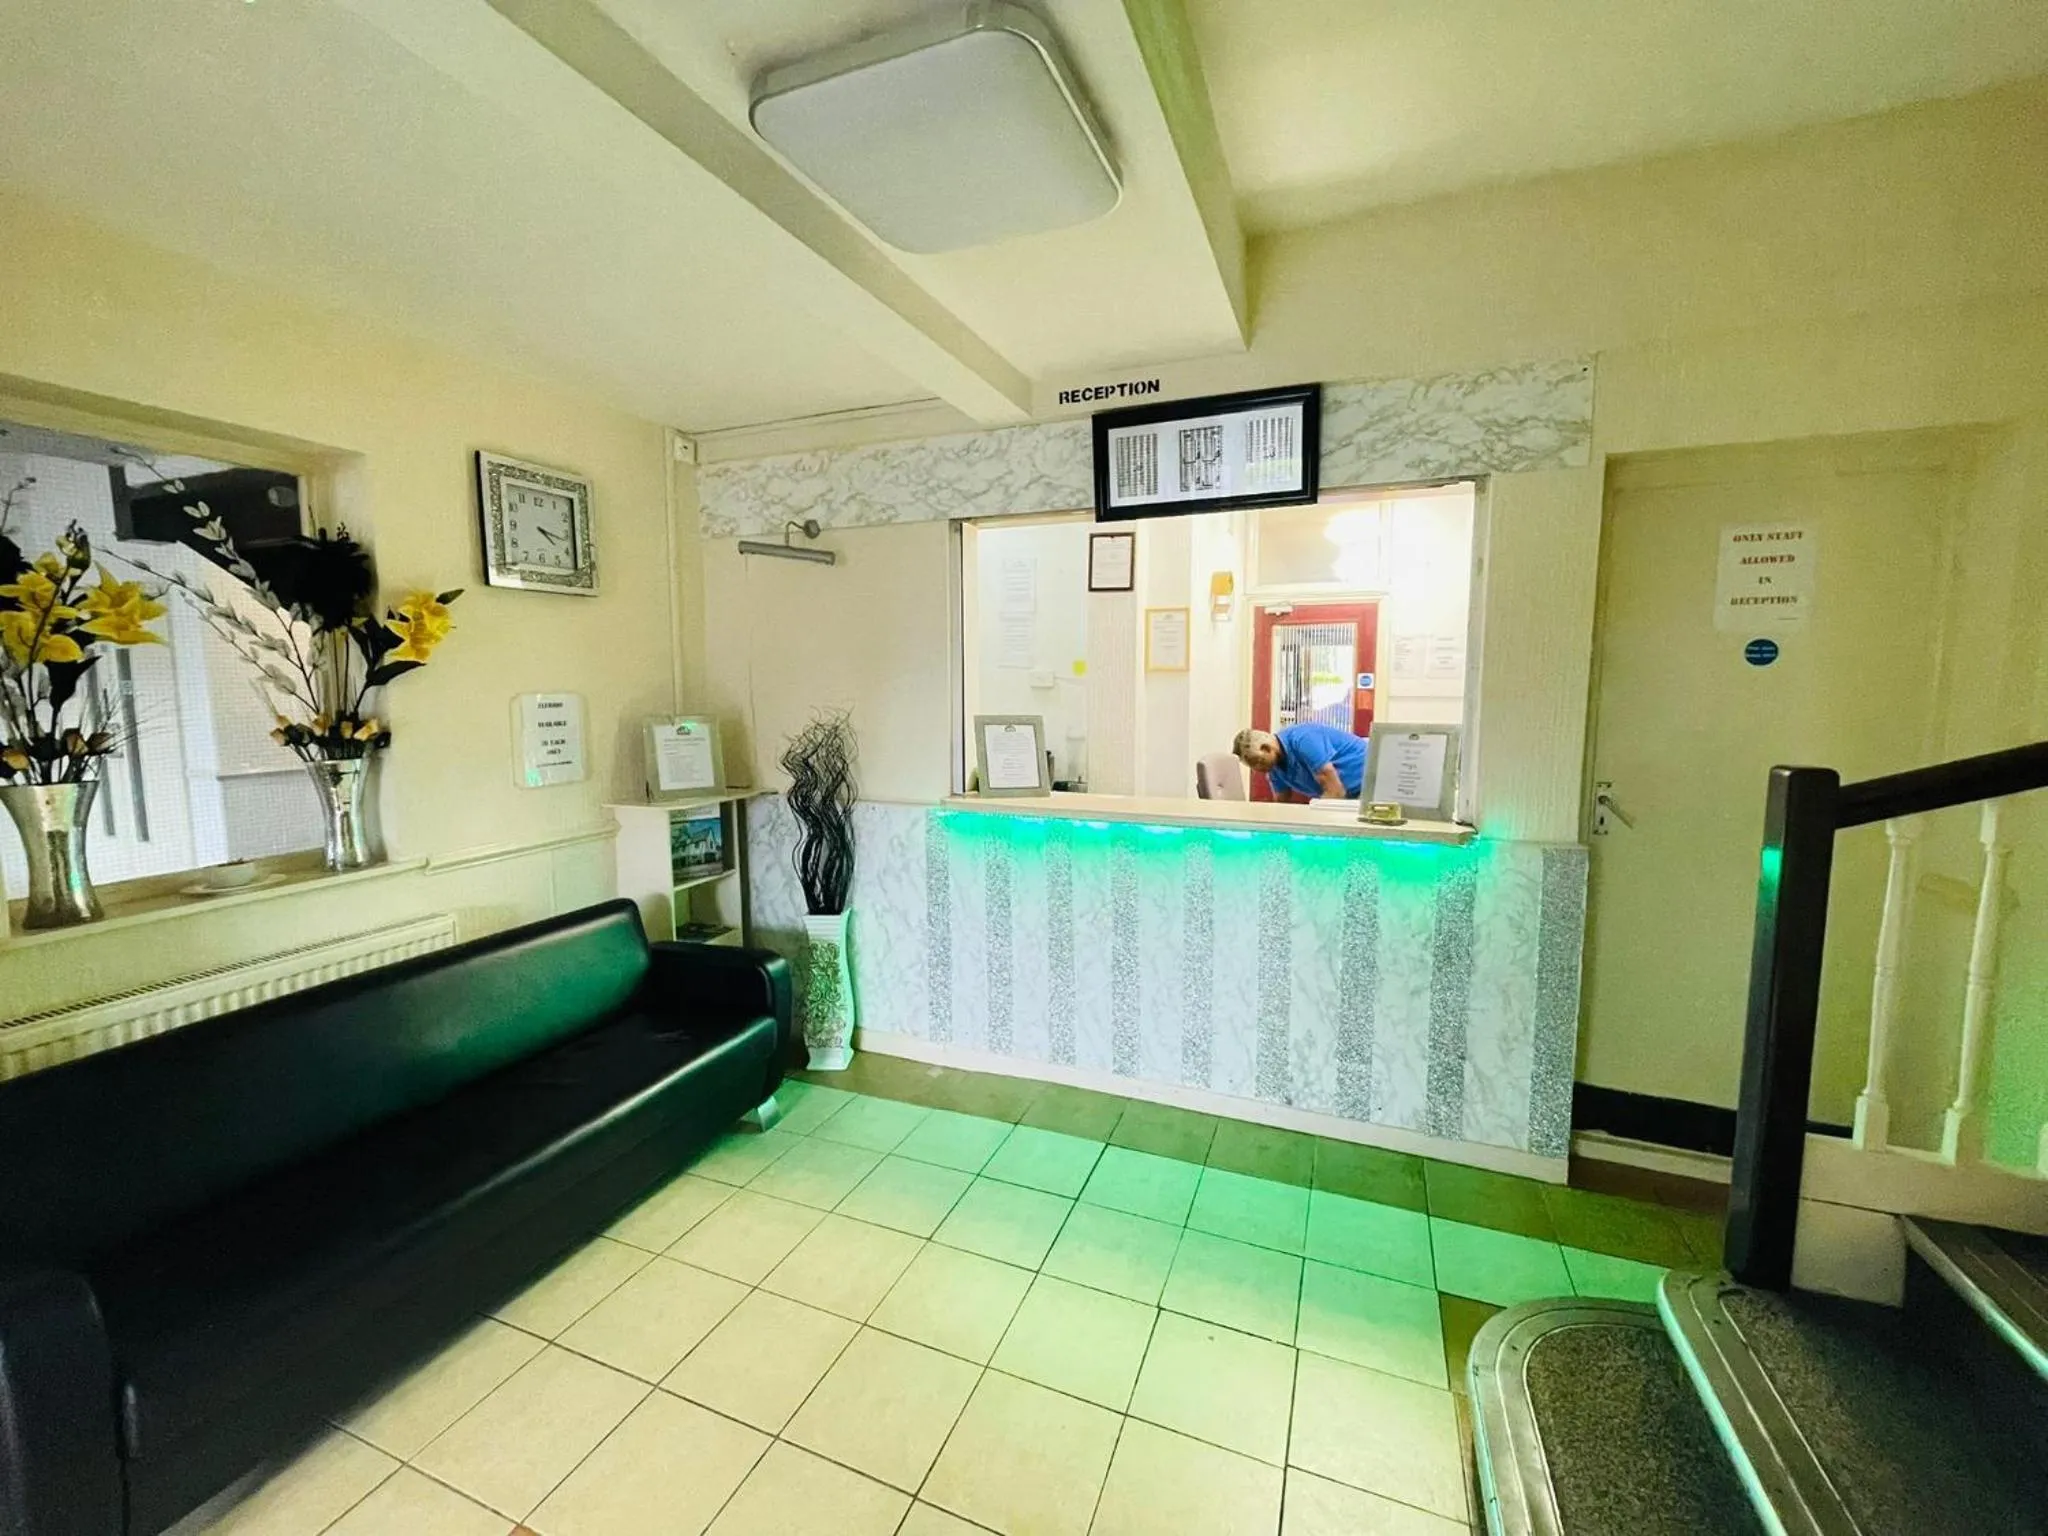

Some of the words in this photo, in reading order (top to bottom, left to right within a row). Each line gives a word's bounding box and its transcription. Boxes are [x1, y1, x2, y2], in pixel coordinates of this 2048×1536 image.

[1059, 379, 1160, 404] RECEPTION
[534, 496, 544, 508] 12
[561, 512, 569, 523] 2
[1732, 533, 1763, 543] ONLY
[1767, 531, 1803, 541] STAFF
[1740, 554, 1796, 565] ALLOWED
[1758, 576, 1772, 585] IN
[1730, 596, 1798, 606] RECEPTION
